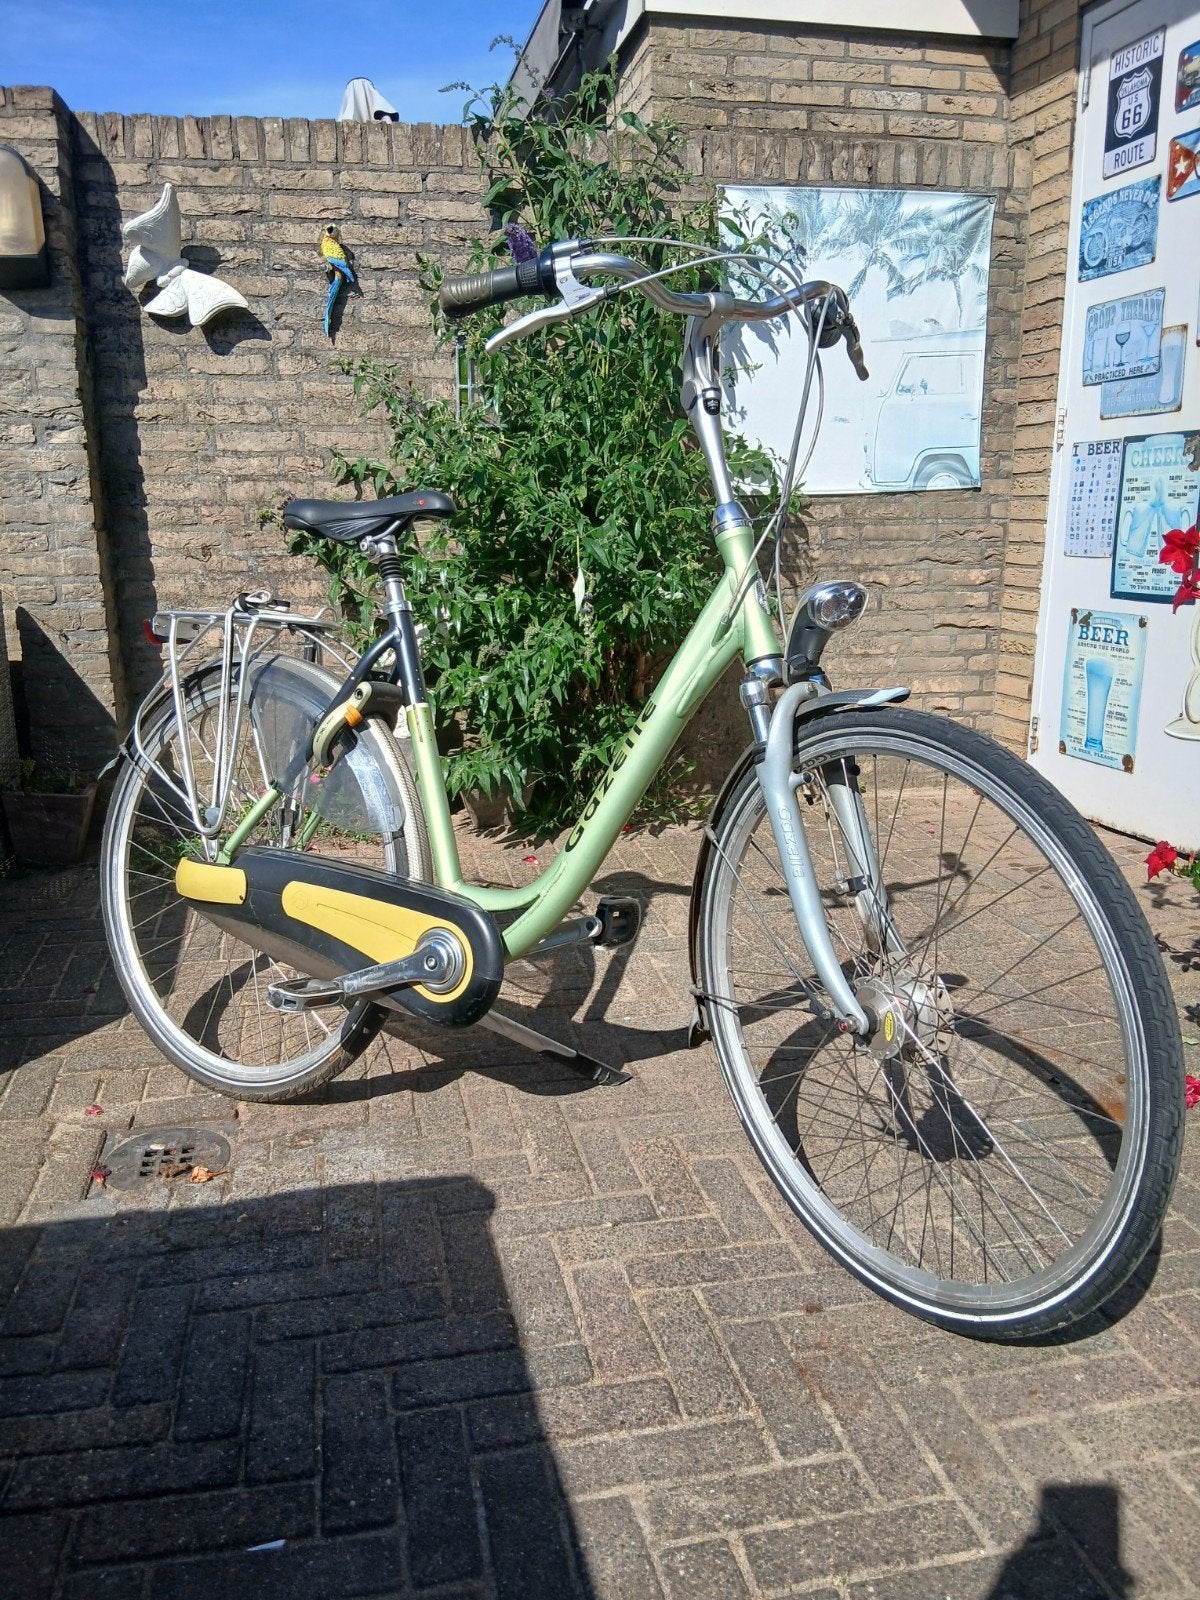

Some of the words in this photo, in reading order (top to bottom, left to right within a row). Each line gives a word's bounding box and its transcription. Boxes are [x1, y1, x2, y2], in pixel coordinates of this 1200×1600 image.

[1114, 35, 1160, 74] HISTORIC
[1120, 76, 1148, 97] OKLAHOMA
[1128, 93, 1140, 106] US
[1121, 104, 1143, 130] 66
[1113, 143, 1145, 170] ROUTE
[1083, 193, 1118, 231] LEGENDS
[1119, 188, 1145, 202] NEVER
[1144, 190, 1159, 209] DIE
[1087, 306, 1117, 342] GROUP
[1121, 298, 1162, 322] THERAPY
[1094, 370, 1126, 382] PRACTICED
[1072, 444, 1080, 457] I
[1087, 440, 1121, 456] BEER
[1077, 641, 1098, 650] AROUND
[1110, 645, 1131, 654] WORLD
[1078, 625, 1129, 646] BEER
[564, 700, 657, 853] Gazelle
[778, 807, 806, 878] Gazelle
